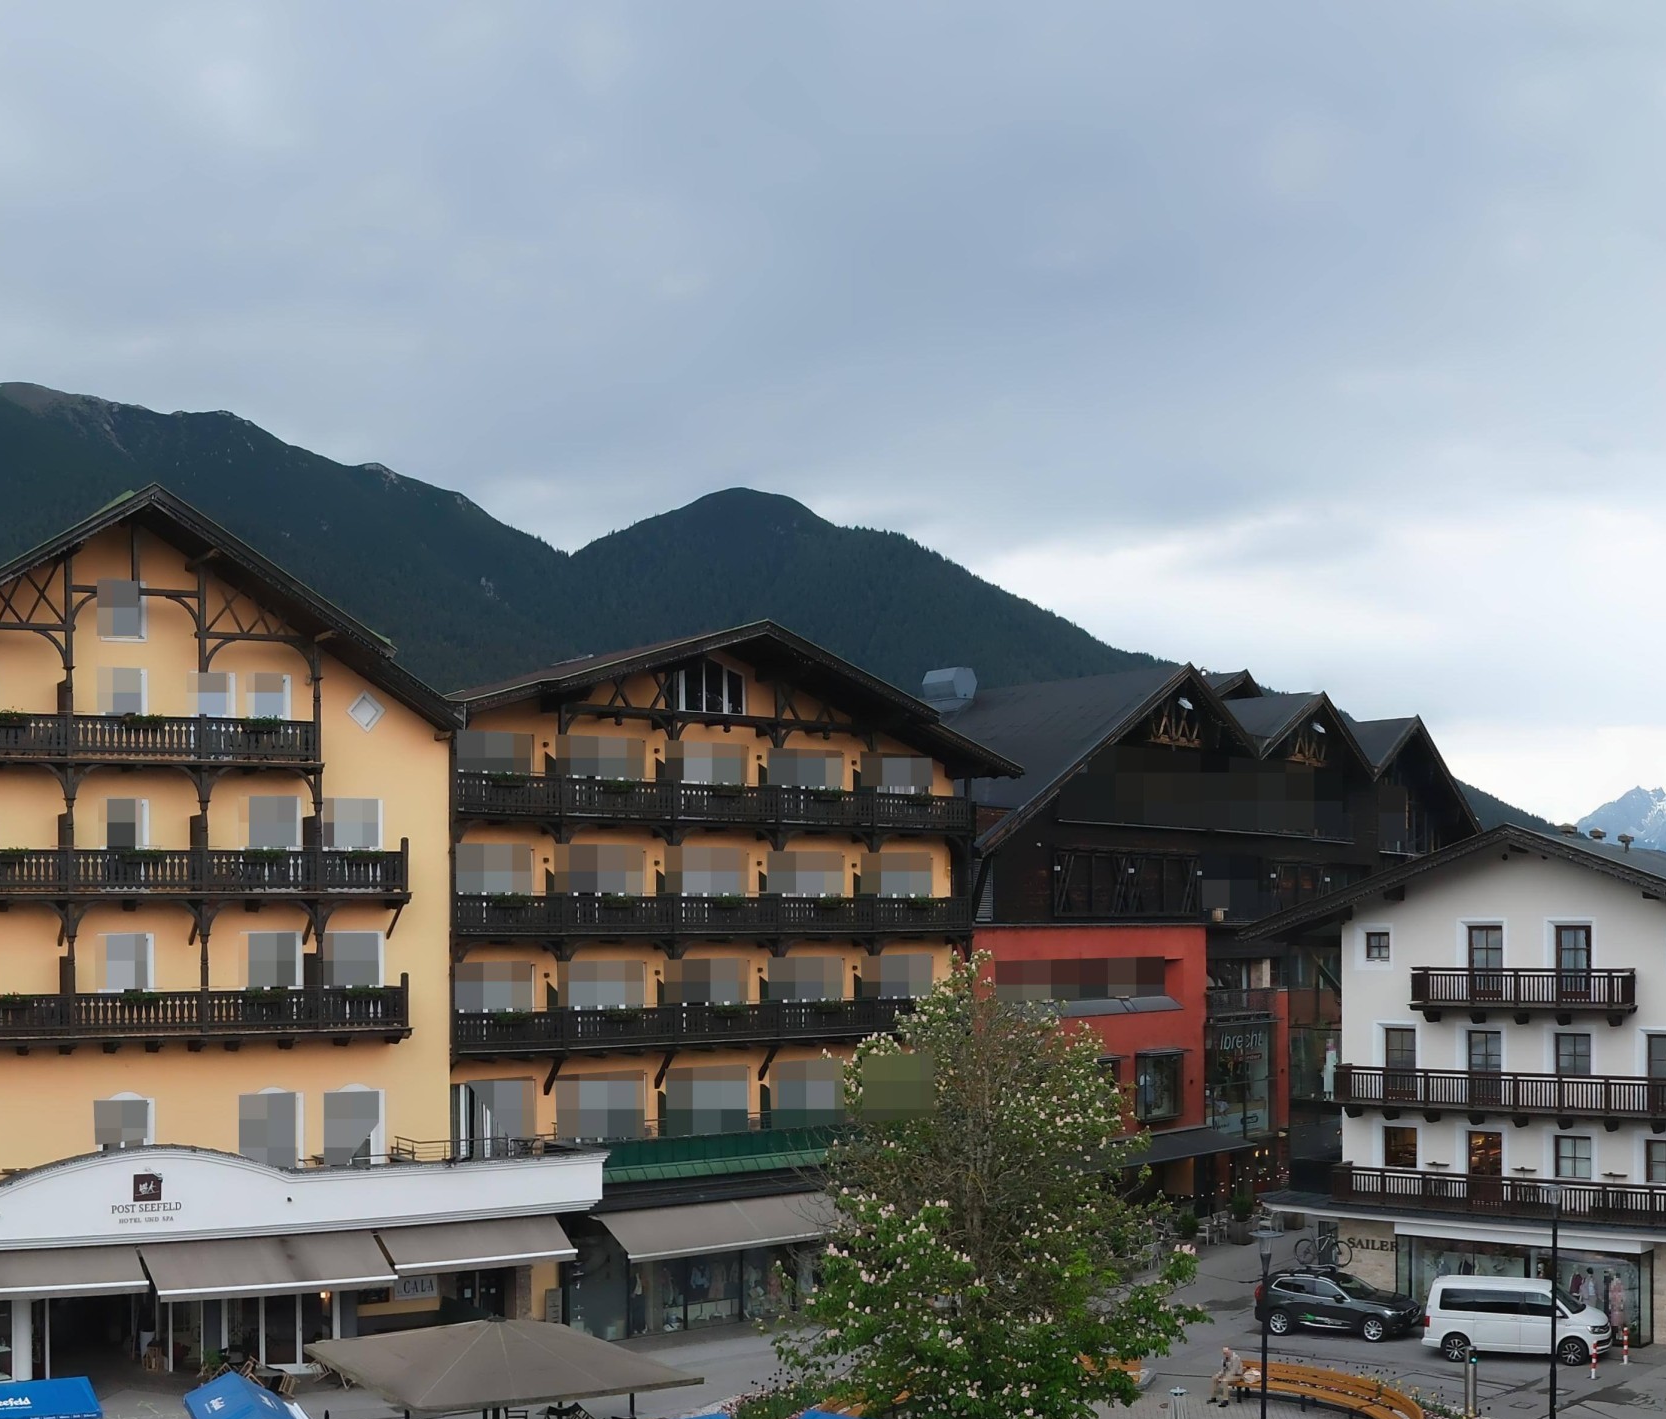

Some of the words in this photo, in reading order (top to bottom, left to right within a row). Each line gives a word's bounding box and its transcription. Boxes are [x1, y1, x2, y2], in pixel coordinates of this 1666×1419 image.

[111, 1205, 134, 1215] POST
[136, 1201, 182, 1213] SEEFELD
[1346, 1237, 1398, 1253] SAILER
[403, 1279, 435, 1294] CALA
